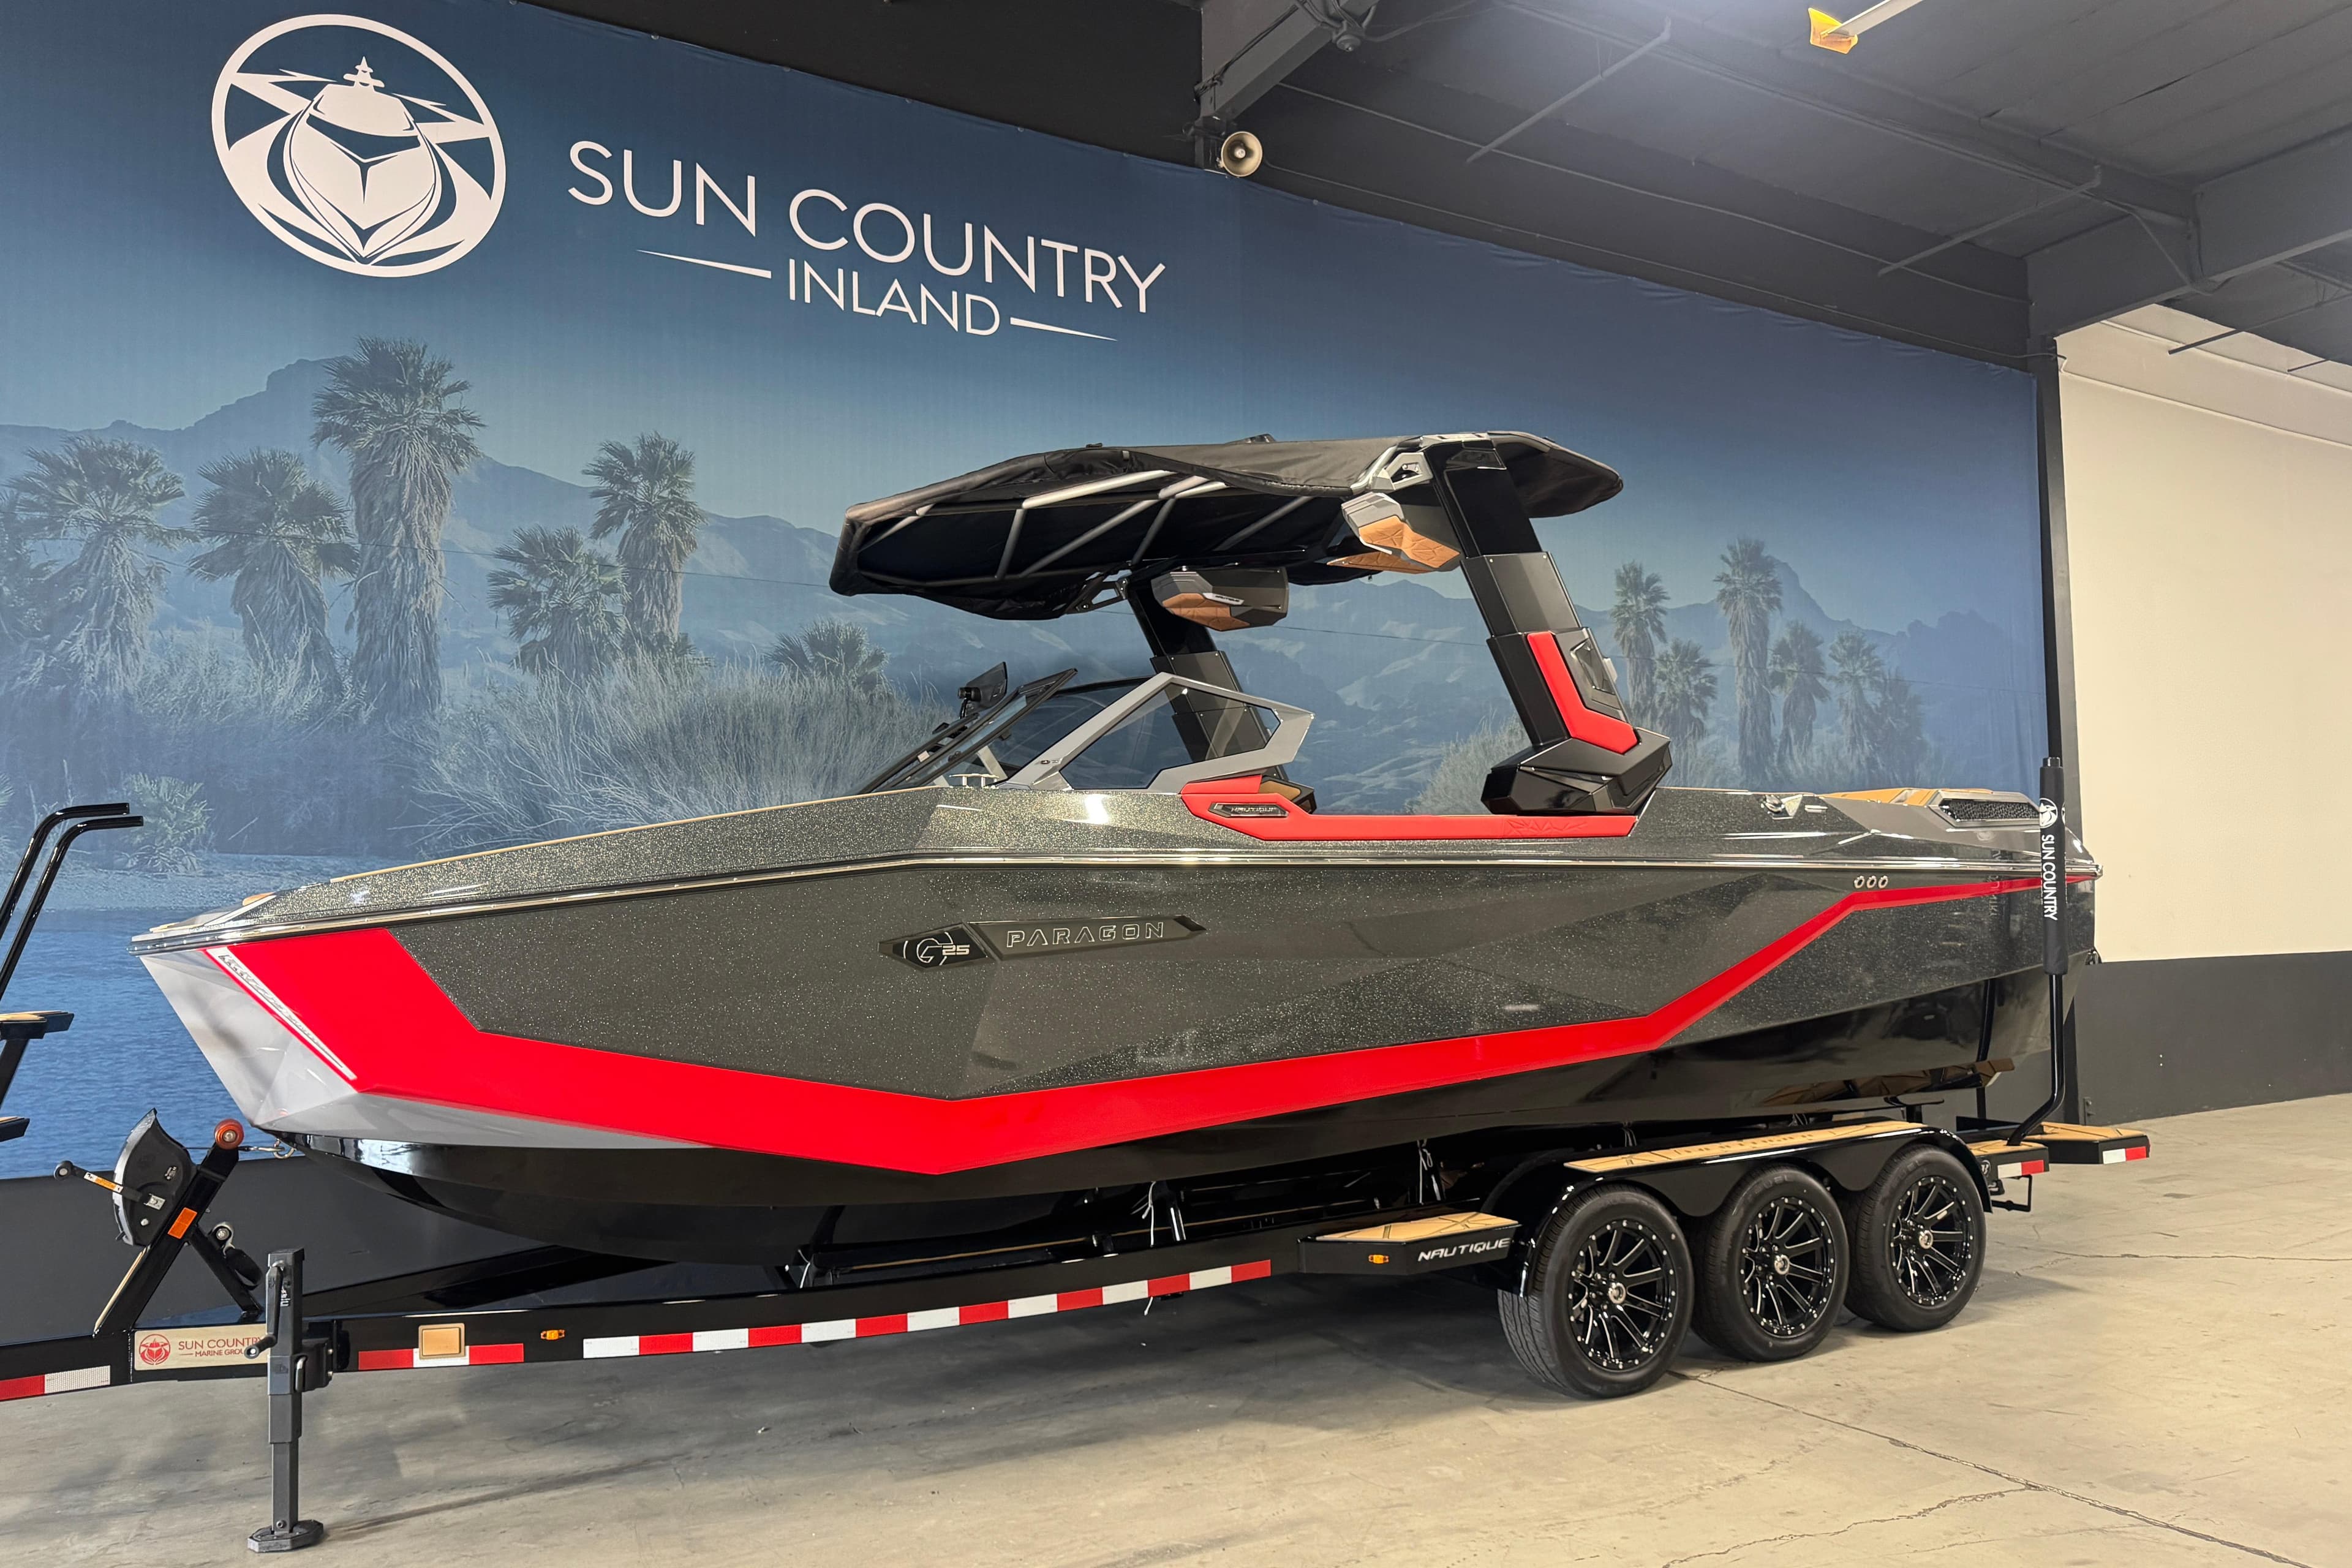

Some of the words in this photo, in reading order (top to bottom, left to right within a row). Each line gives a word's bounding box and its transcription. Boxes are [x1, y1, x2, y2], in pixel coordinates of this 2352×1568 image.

[568, 140, 756, 238] SUN
[789, 189, 1166, 313] COUNTRY
[789, 258, 1000, 336] INLAND
[2041, 834, 2056, 860] SUN
[2042, 862, 2058, 921] COUNTRY
[1007, 922, 1164, 948] PARAGON
[1417, 1237, 1512, 1262] NAUTIQUE
[178, 1340, 204, 1351] SUN
[195, 1349, 223, 1357] MARINE
